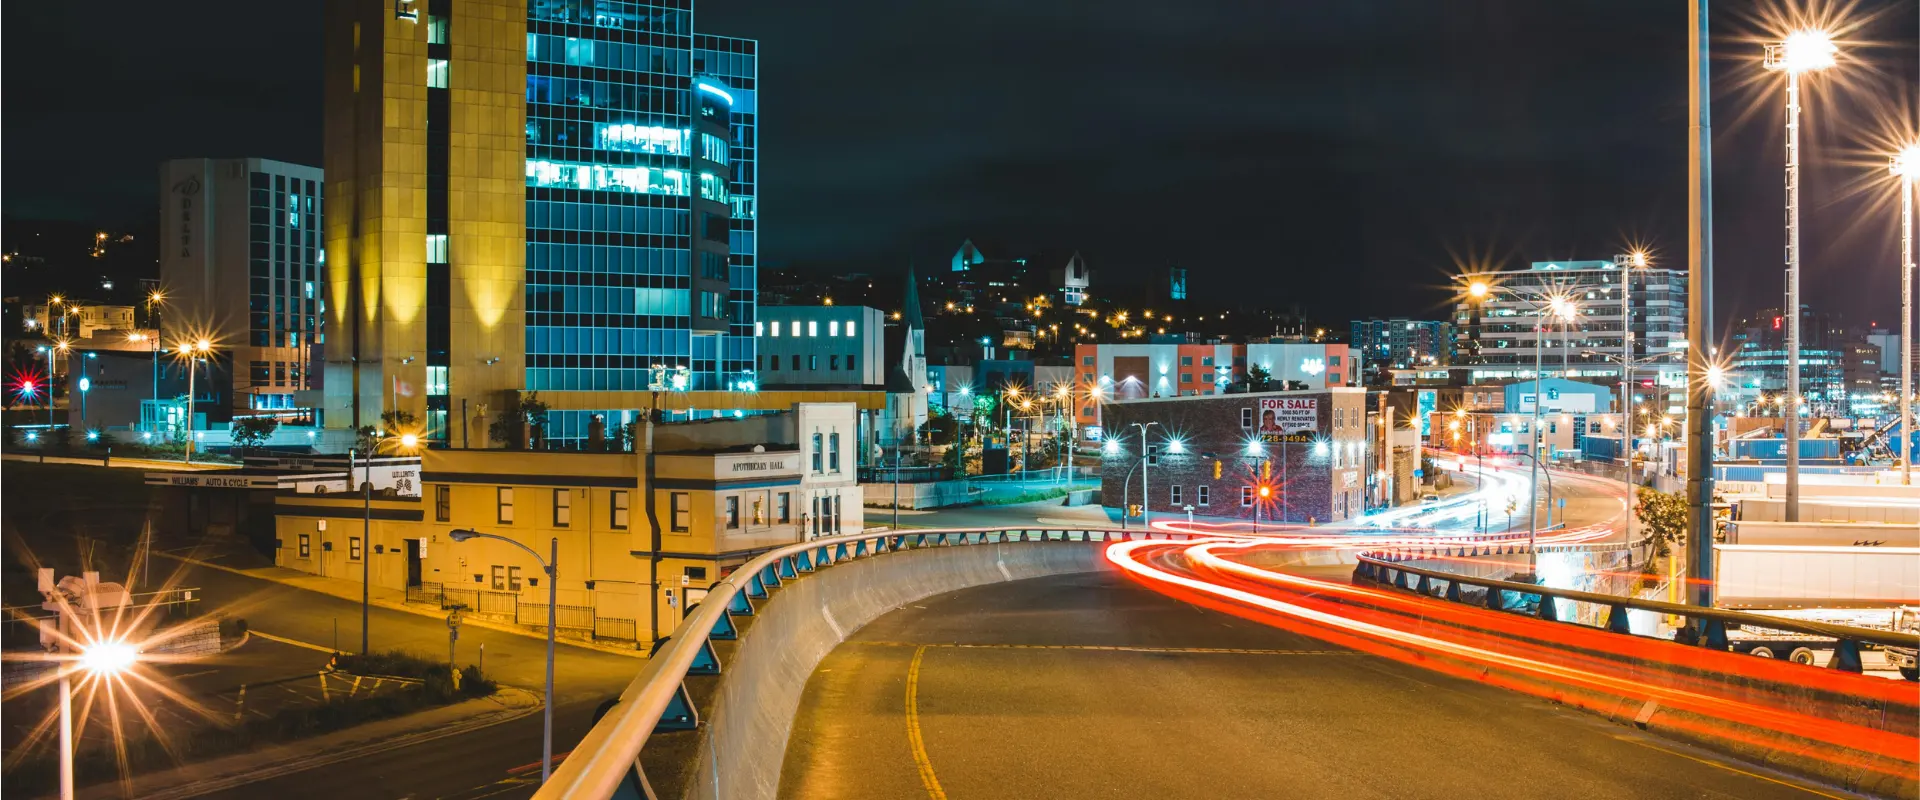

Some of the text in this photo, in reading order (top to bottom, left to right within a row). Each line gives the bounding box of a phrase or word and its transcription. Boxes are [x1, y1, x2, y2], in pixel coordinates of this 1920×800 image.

[181, 198, 191, 258] DELTA
[1262, 399, 1316, 409] FOR SALE
[732, 461, 784, 471] APOTHECARY HALL
[205, 478, 222, 486] AUTO
[223, 478, 228, 486] &
[229, 478, 248, 487] CYCLE
